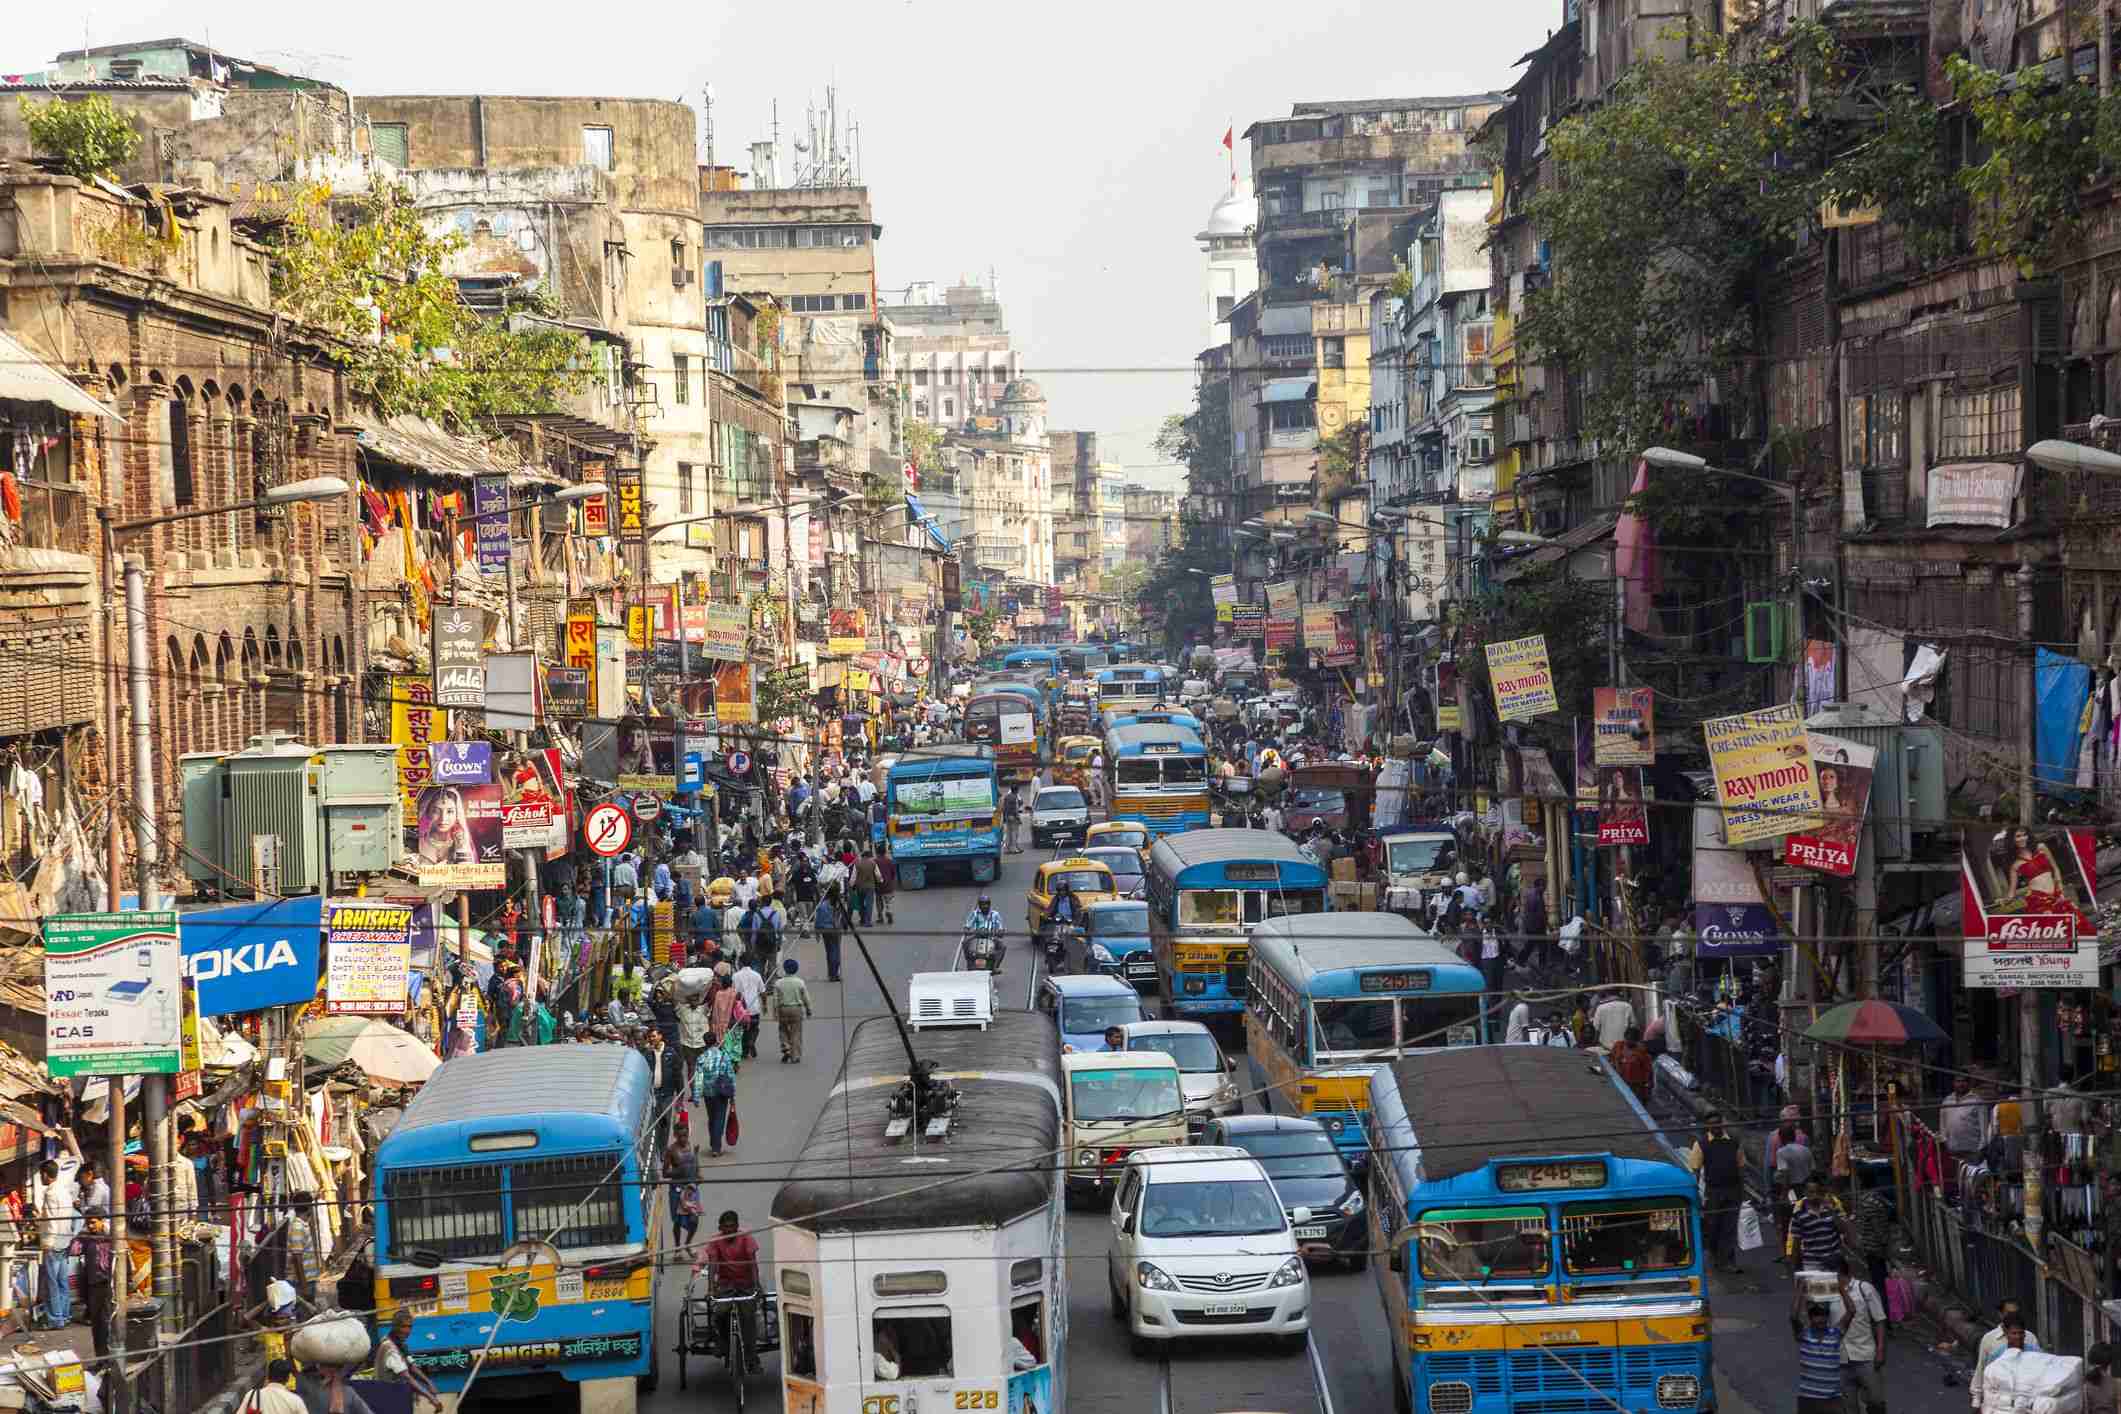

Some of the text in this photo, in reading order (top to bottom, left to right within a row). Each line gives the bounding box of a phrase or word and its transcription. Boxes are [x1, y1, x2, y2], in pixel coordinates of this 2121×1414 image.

[441, 668, 482, 692] Mala
[1497, 671, 1549, 694] Raymond
[438, 758, 482, 776] CROWN
[1724, 760, 1809, 799] Raymond
[1770, 793, 1802, 809] WEAR
[502, 805, 548, 823] Ashok
[1727, 812, 1761, 826] DRESS
[1602, 823, 1644, 839] PRIYA
[1791, 843, 1849, 865] PRIYA
[331, 909, 411, 931] ABHISHEK
[1702, 925, 1764, 946] CROWN
[1989, 918, 2067, 944] Ashok
[56, 1025, 94, 1038] CAS
[470, 1343, 560, 1362] DANGER
[955, 1391, 999, 1410] 228
